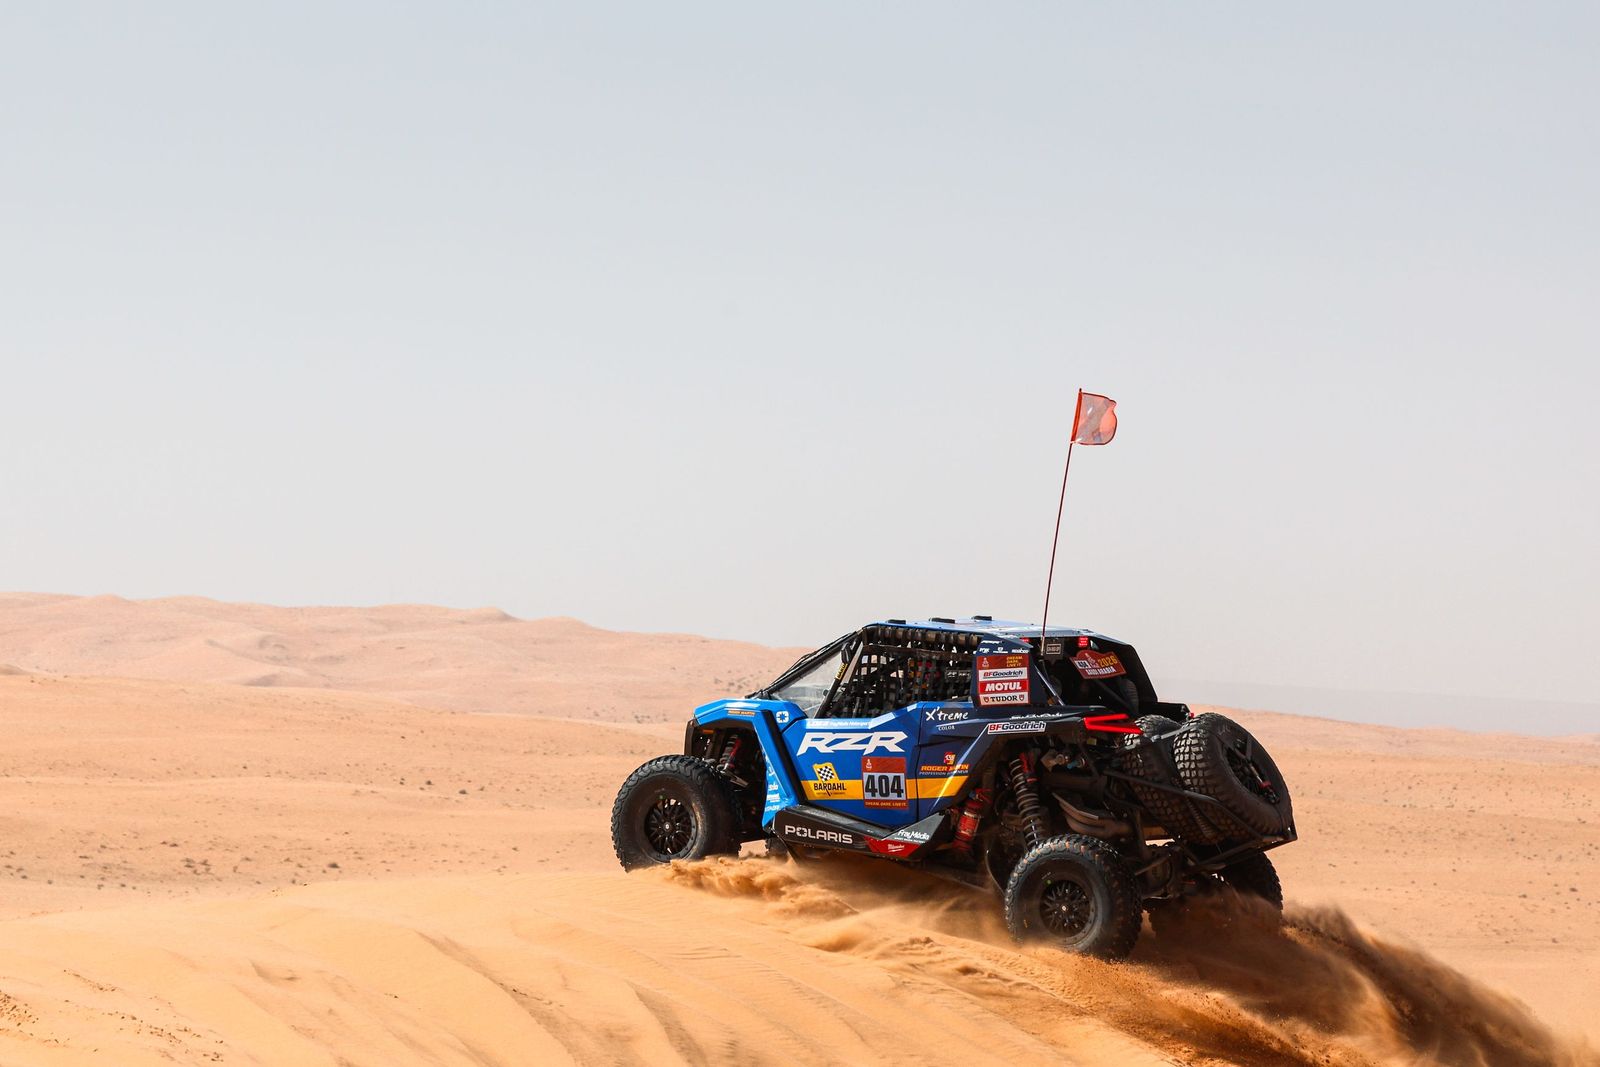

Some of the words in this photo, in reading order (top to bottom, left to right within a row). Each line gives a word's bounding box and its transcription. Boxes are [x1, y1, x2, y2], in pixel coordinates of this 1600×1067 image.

[1097, 655, 1118, 667] 2026
[985, 682, 1022, 691] MOTUL
[989, 721, 1046, 731] BFGoodrich
[796, 731, 909, 756] RZR
[813, 782, 847, 791] BARDAHL
[864, 774, 904, 798] 404
[784, 824, 853, 844] POLARIS
